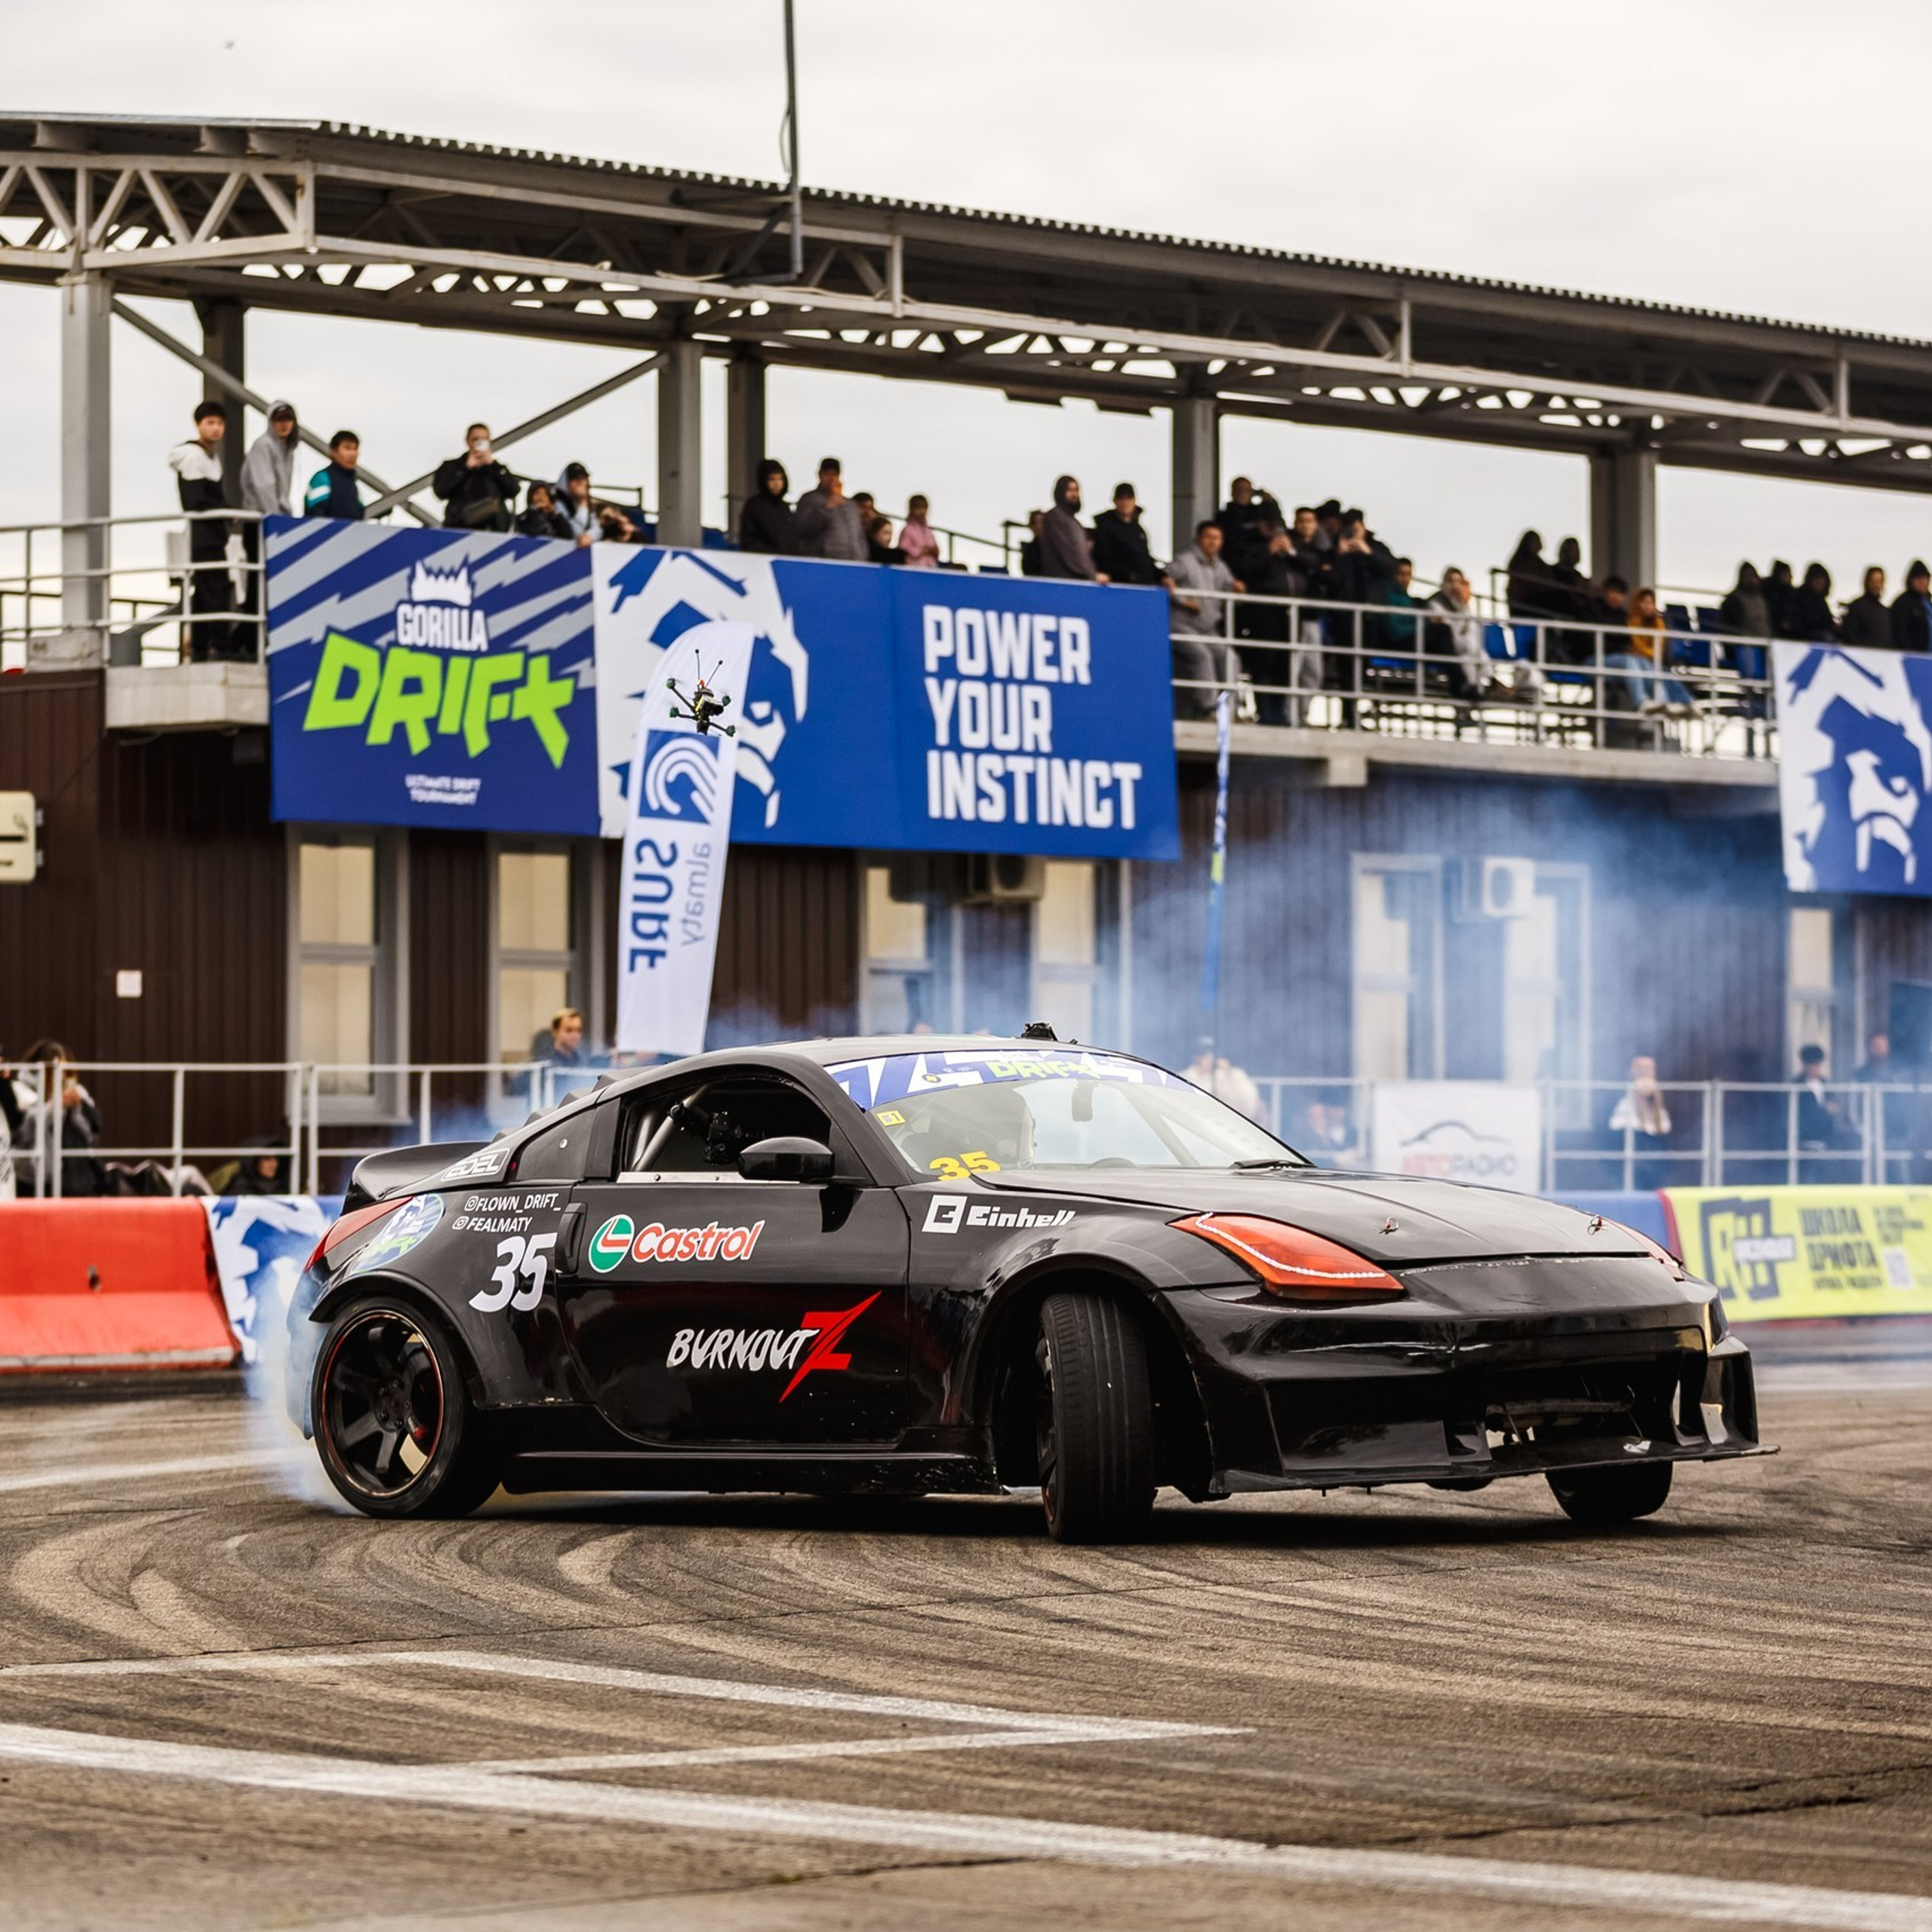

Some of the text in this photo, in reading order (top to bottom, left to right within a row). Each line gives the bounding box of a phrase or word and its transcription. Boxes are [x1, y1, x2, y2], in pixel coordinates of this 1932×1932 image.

[397, 604, 488, 651] GORILLA
[922, 605, 1091, 685] POWER
[303, 632, 575, 769] DRIFT
[924, 678, 1052, 753] YOUR
[927, 750, 1142, 830] INSTINCT
[984, 1060, 1102, 1079] DRIFT
[929, 1151, 1001, 1182] 35
[631, 1220, 765, 1263] Castrol
[966, 1204, 1076, 1229] Einhell
[469, 1232, 558, 1312] 35
